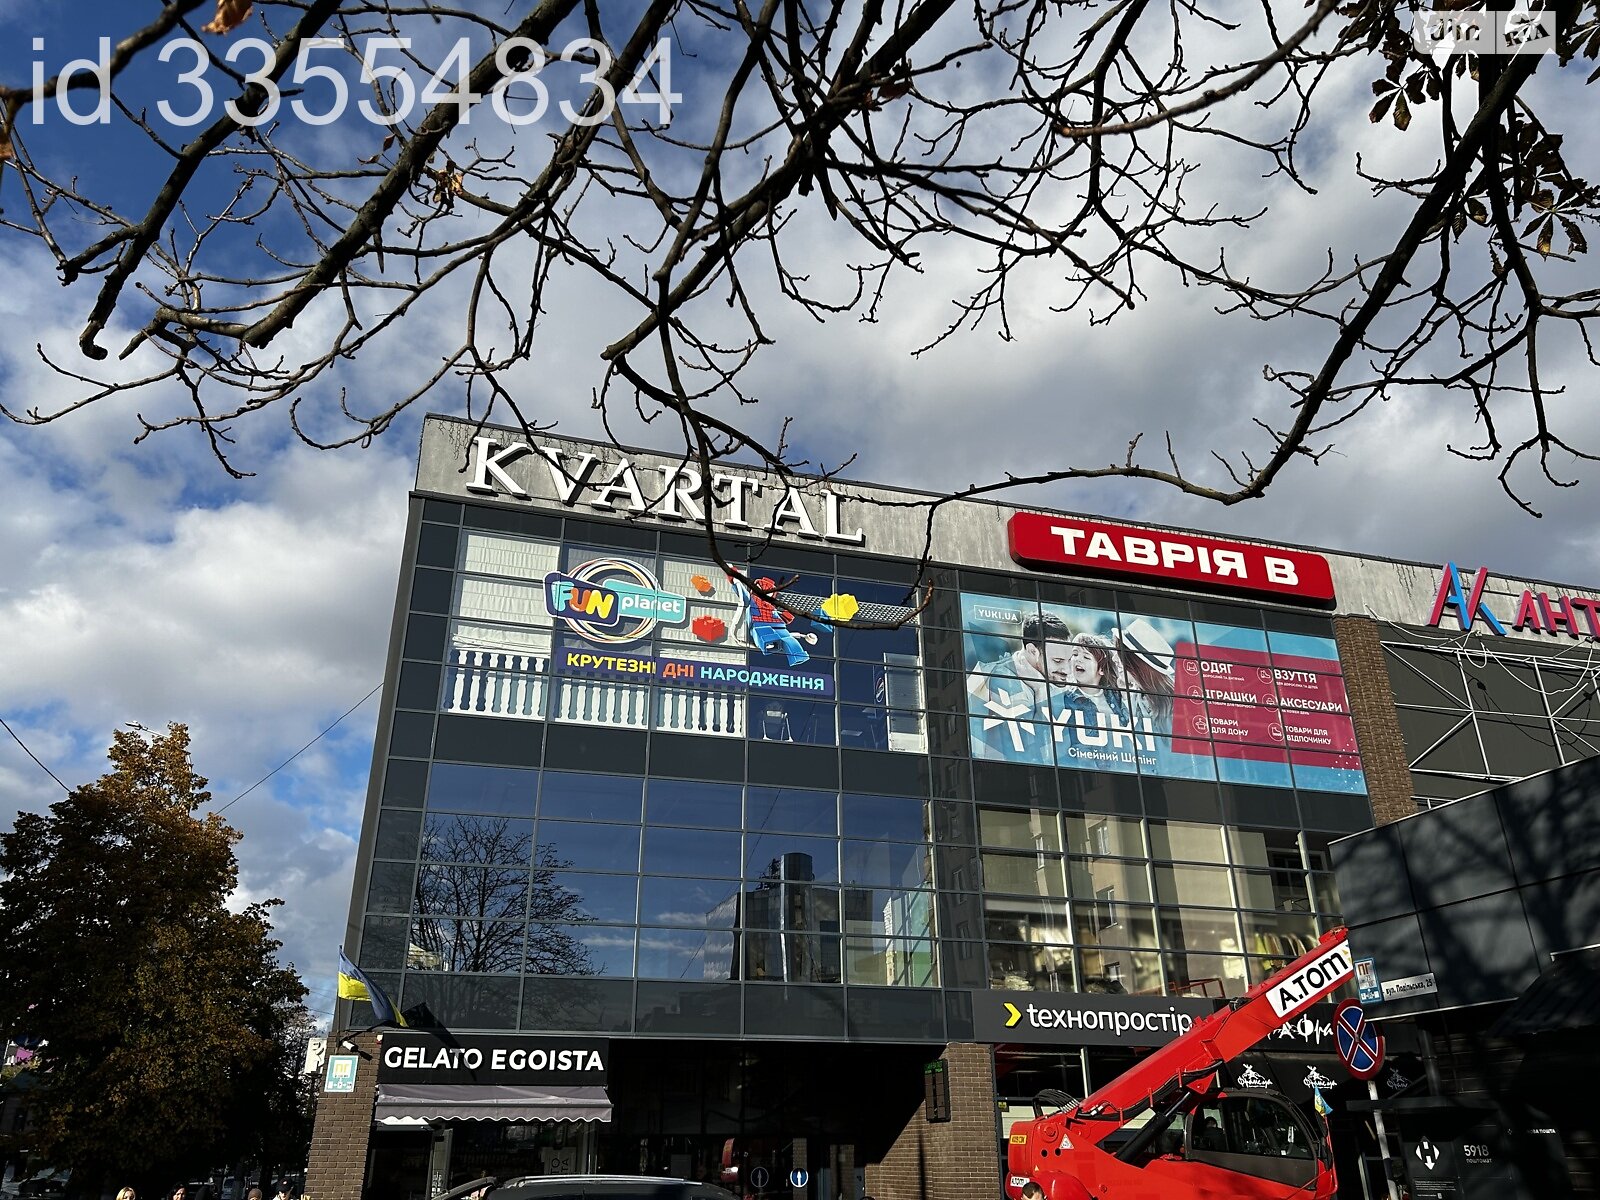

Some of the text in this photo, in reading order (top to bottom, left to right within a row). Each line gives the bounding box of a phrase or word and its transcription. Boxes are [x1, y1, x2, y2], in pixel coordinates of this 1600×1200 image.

[466, 436, 864, 543] KVARTAL
[1050, 526, 1299, 586] ТАВРІЯ В
[552, 580, 682, 619] FUN planet
[978, 608, 1018, 622] YUKI.UA
[1200, 661, 1234, 674] ОДЯГ
[662, 662, 695, 678] ДНІ
[700, 666, 825, 691] НАРОДЖЕННЯ
[1273, 669, 1318, 684] ВЗУТТЯ
[1205, 689, 1258, 703] ІГРАШКИ
[1280, 697, 1343, 713] АКСЕСУАРИ
[1041, 706, 1156, 752] YUKI
[1209, 718, 1239, 727] ТОВАРИ
[1211, 727, 1248, 736] ДЛЯ ДОМУ
[1284, 725, 1328, 736] ТОВАРИ ДЛЯ
[1286, 735, 1332, 745] ВІДПОЧИНКУ
[1068, 747, 1119, 761] Сімейний
[384, 1046, 605, 1072] GELATO EGOISTA
[1463, 1144, 1490, 1157] 5918
